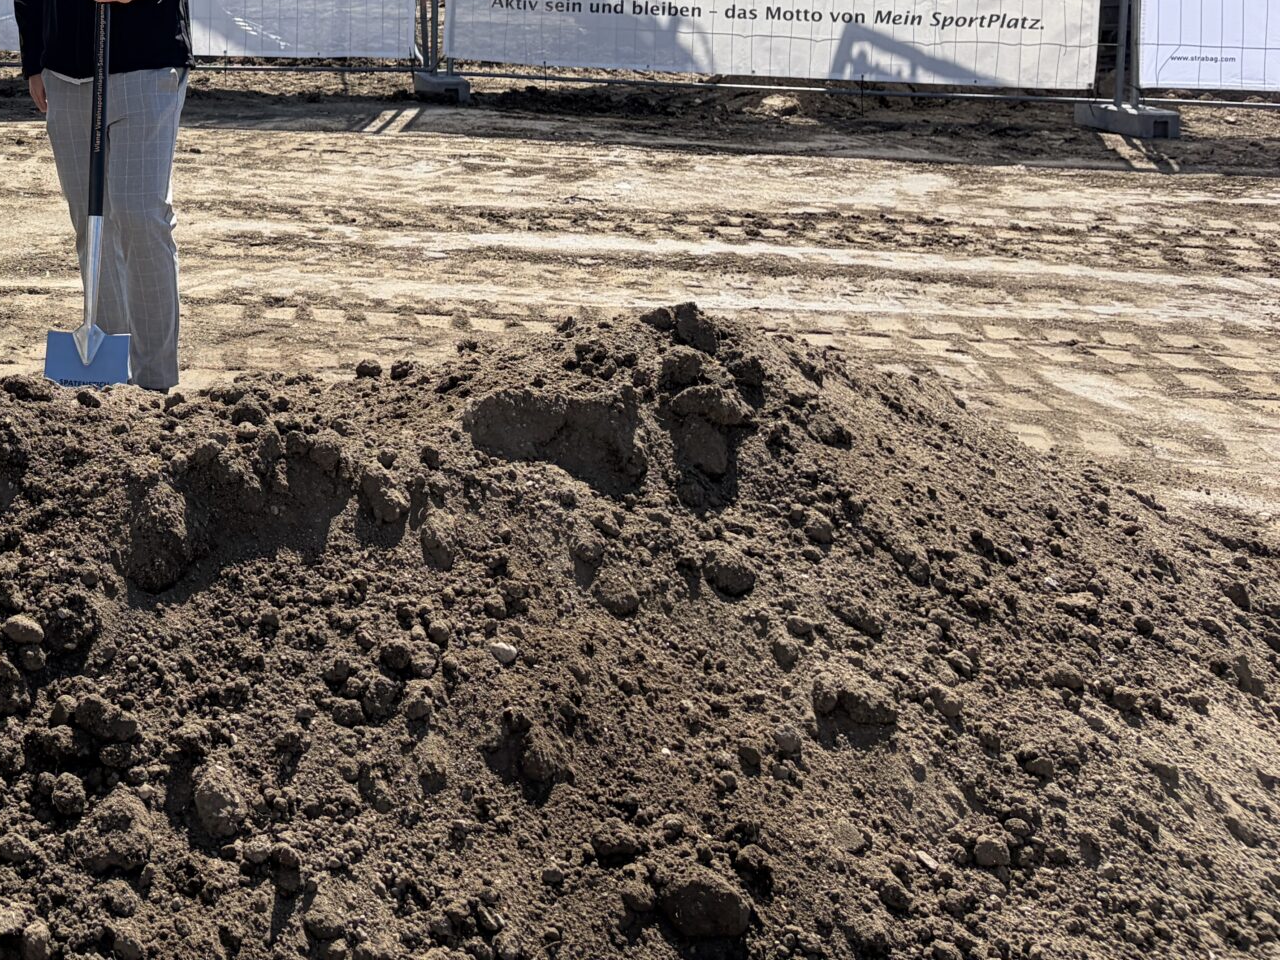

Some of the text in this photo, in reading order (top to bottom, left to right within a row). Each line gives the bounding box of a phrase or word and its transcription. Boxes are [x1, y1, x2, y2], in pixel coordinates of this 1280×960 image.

[589, 0, 624, 15] und
[632, 0, 702, 17] bleiben
[724, 4, 758, 20] das
[765, 6, 823, 22] Motto
[830, 10, 865, 24] von
[874, 10, 922, 26] Mein
[930, 11, 1045, 30] SportPlatz.
[1170, 55, 1236, 63] www.strabag.com
